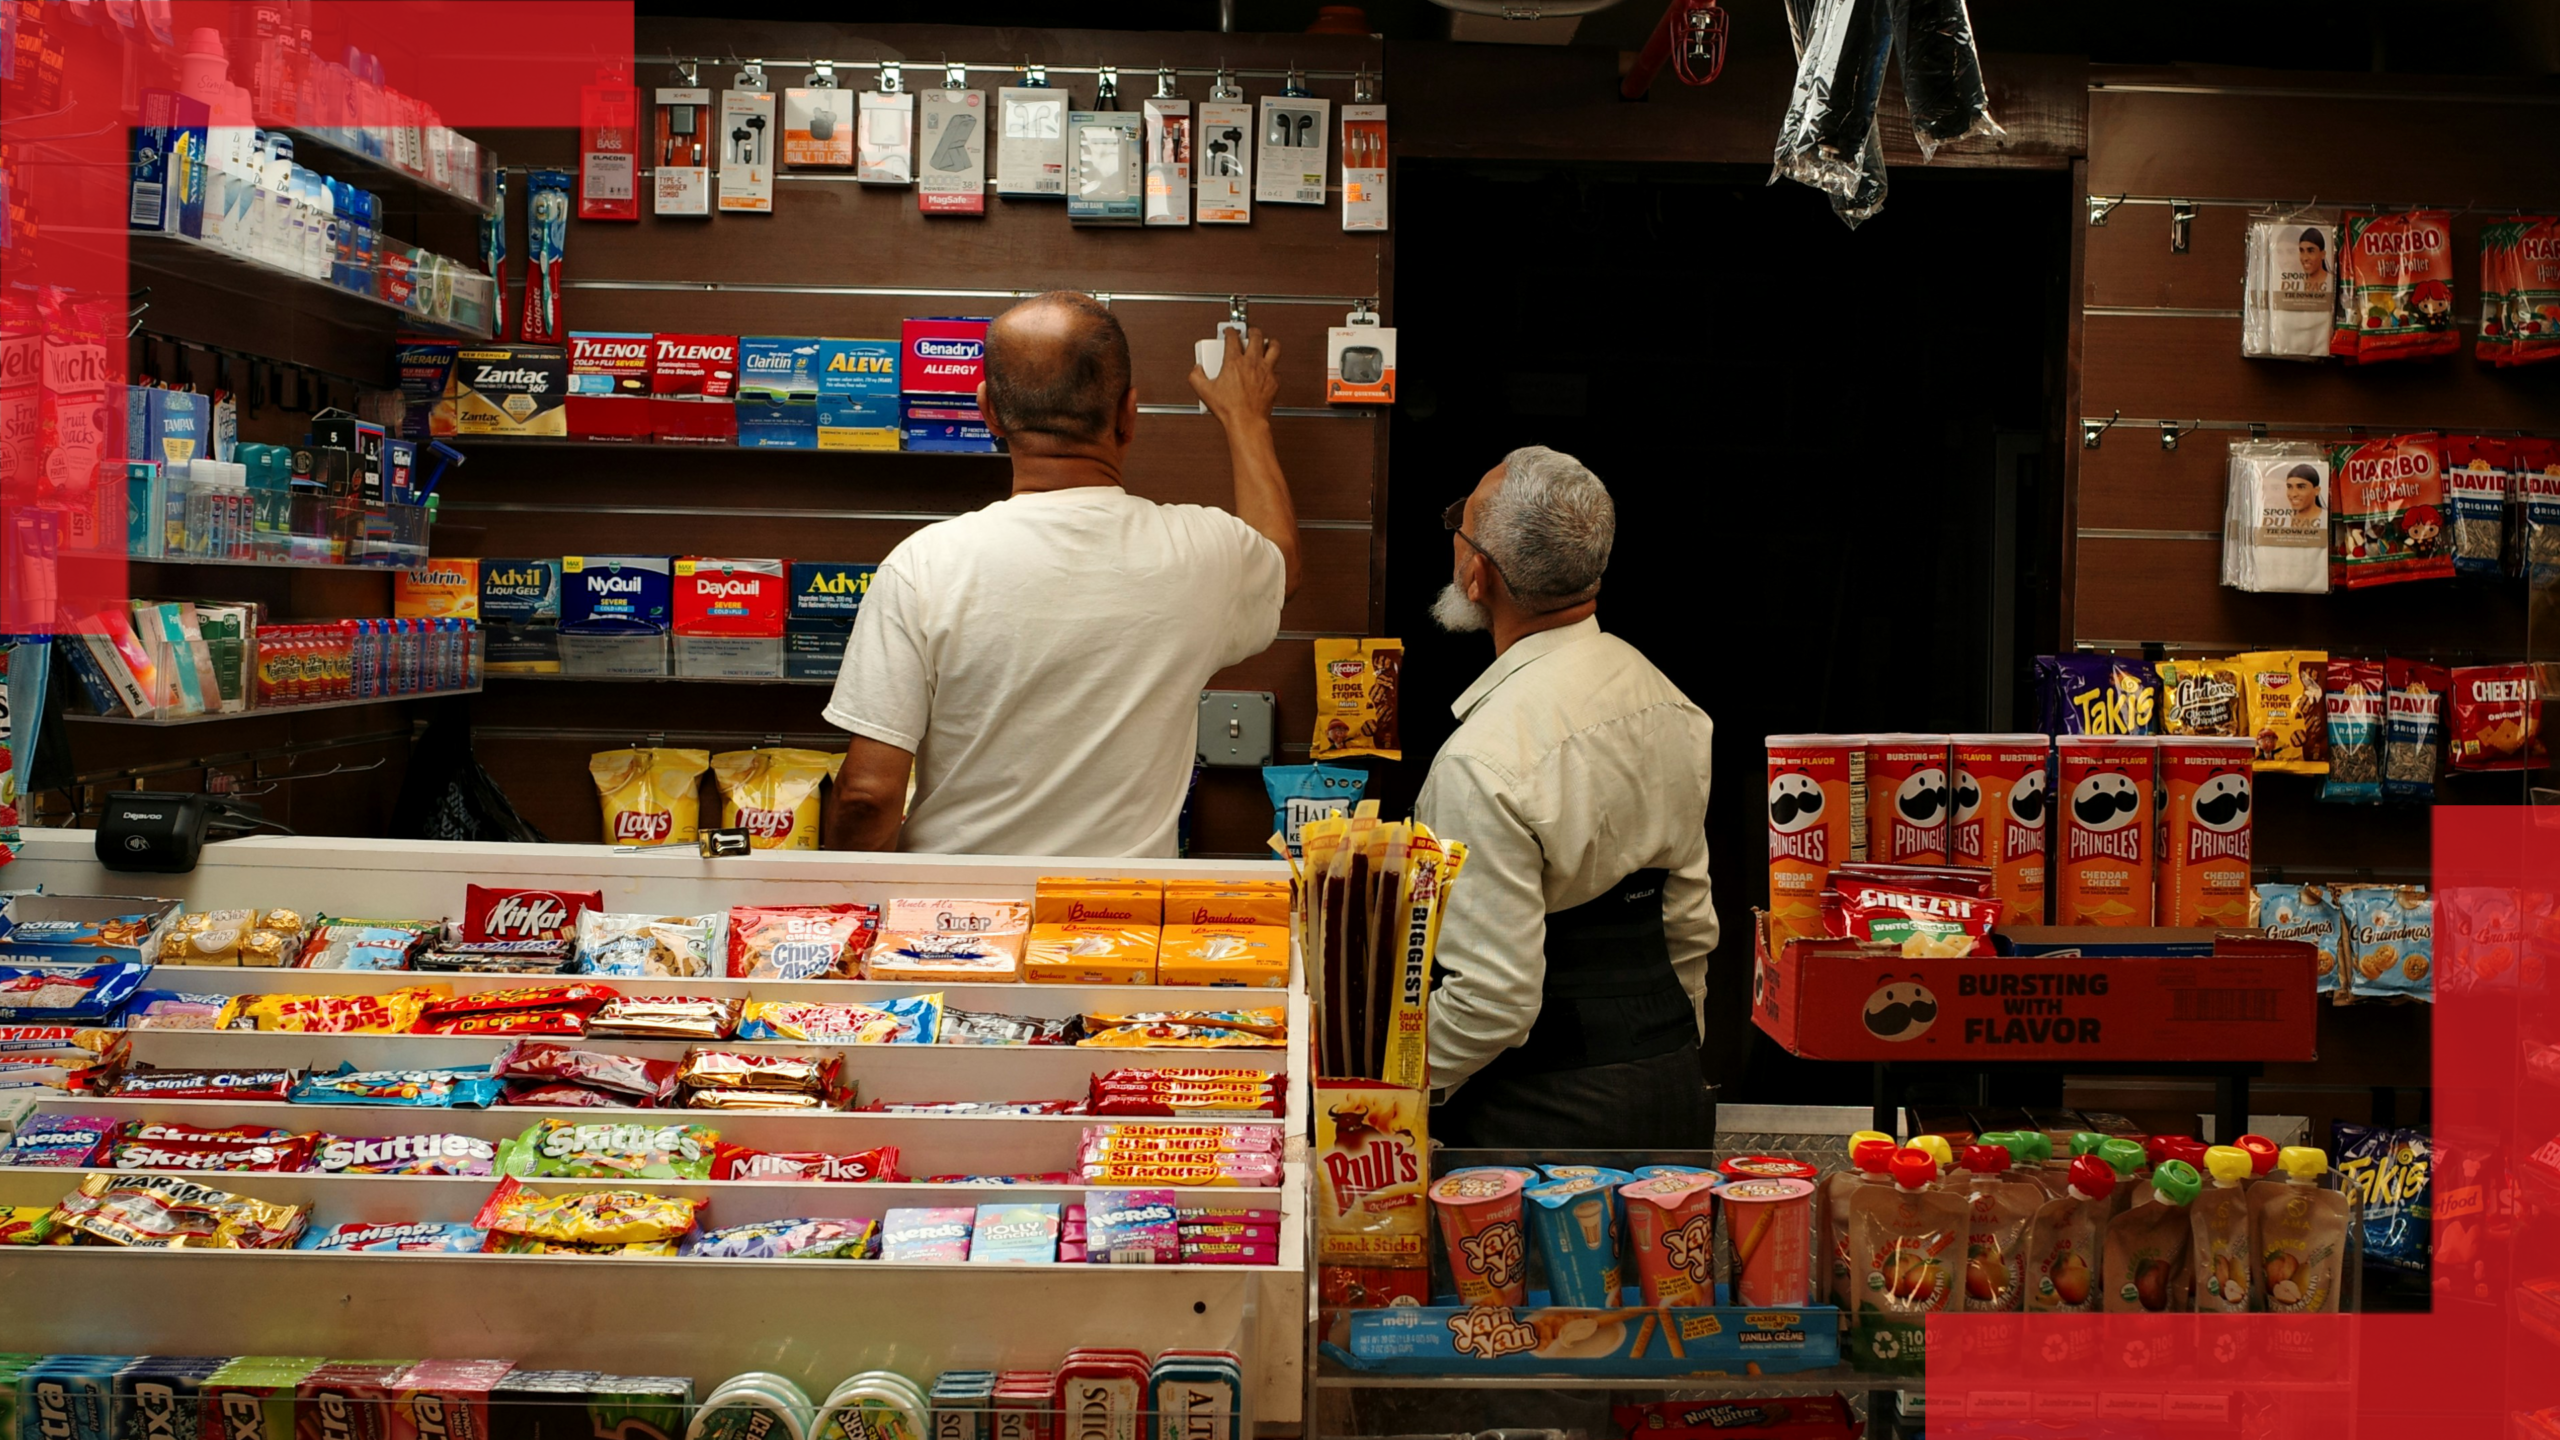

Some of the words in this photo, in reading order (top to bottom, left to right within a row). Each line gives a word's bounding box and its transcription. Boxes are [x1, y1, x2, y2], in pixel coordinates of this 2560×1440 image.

[597, 140, 621, 149] BASS
[787, 152, 810, 162] BUILT
[813, 152, 826, 162] TO
[828, 152, 851, 162] LAST
[928, 195, 967, 204] MagSafe
[2364, 229, 2442, 256] HARIBO
[390, 256, 410, 270] Colgate
[2377, 259, 2400, 278] Harry
[2400, 256, 2430, 272] Potter
[2281, 271, 2311, 281] SPORT
[390, 282, 409, 297] Colgate
[2281, 282, 2301, 292] DU
[2304, 282, 2328, 292] RAG
[533, 287, 542, 334] Colgate
[572, 340, 648, 360] TYLENOL
[656, 341, 734, 361] TYLENOL
[921, 342, 979, 358] Benadryl
[401, 353, 450, 365] THERAFLU
[746, 354, 792, 369] Claritin
[827, 352, 894, 374] ALEVE
[49, 350, 107, 386] Welch's
[657, 368, 676, 376] Extra
[924, 365, 978, 375] ALLERGY
[473, 365, 549, 386] Zantac
[459, 411, 500, 424] Zantac
[163, 418, 195, 433] TAMPAX
[61, 426, 95, 447] Snacks
[2350, 453, 2430, 484] HARIBO
[2453, 472, 2506, 491] DAVID
[2362, 486, 2388, 506] Harry
[2389, 482, 2420, 500] Potter
[2263, 508, 2299, 517] SPORT
[2457, 502, 2503, 512] ORIGINAL
[2262, 517, 2287, 529] DU
[2292, 517, 2321, 528] RAG
[2301, 528, 2319, 536] CAP
[678, 564, 692, 572] MAX
[407, 570, 462, 586] Motrin
[485, 568, 541, 587] Advil
[807, 571, 878, 594] Advil
[486, 585, 541, 596] LIQUI-GELS
[588, 576, 642, 596] NyQuil
[696, 579, 760, 598] DayQuil
[1331, 662, 1364, 676] Keebler
[2258, 672, 2291, 686] Keebler
[1332, 683, 1363, 692] FUDGE
[2472, 680, 2538, 703] CHEEZ-IT
[1331, 692, 1364, 700] STRIPES
[2169, 679, 2239, 722] Linden's
[2260, 693, 2291, 702] FUDGE
[1338, 700, 1358, 708] Minis
[2073, 686, 2155, 736] Takis
[2259, 701, 2292, 710] STRIPES
[2186, 705, 2228, 720] Chocolate
[2267, 710, 2288, 718] Minis
[2488, 710, 2523, 722] ORIGINAL
[2189, 712, 2229, 728] Chippers
[2393, 724, 2439, 736] ORIGINAL
[1802, 757, 1836, 766] FLAVOR
[1886, 753, 1928, 761] BURSTING
[1962, 753, 1992, 762] FLAVOR
[2000, 754, 2037, 762] BURSTING
[2066, 756, 2103, 765] BURSTING
[2121, 757, 2148, 765] FLAVOR
[2184, 757, 2227, 765] BURSTING
[123, 811, 162, 822] Dejavoo
[738, 806, 792, 839] Lay's
[617, 810, 669, 841] Lay's
[2071, 827, 2138, 860] PRINGLES
[2191, 827, 2250, 860] PRINGLES
[1774, 872, 1814, 882] CHEDDAR
[2080, 870, 2129, 880] CHEDDAR
[2203, 871, 2246, 880] CHEDDAR
[1778, 881, 1806, 889] CHEESE
[2087, 879, 2121, 887] CHEESE
[2211, 879, 2241, 887] CHEESE
[896, 899, 926, 909] Uncle
[1859, 888, 1972, 918] CHEEZ-IT
[485, 897, 568, 937] KitKat
[1068, 901, 1132, 923] Bauducco
[1192, 906, 1257, 926] Bauducco
[935, 911, 991, 932] Sugar
[2359, 924, 2431, 945] Grandma's
[774, 941, 831, 965] Chips
[1404, 906, 1429, 1007] BIGGEST
[1029, 969, 1067, 980] Bauducco
[1083, 970, 1104, 978] Wafer
[1218, 976, 1239, 984] Wafer
[1959, 973, 2109, 997] BURSTING
[2004, 998, 2062, 1016] WITH
[1398, 1009, 1424, 1022] Snack
[1399, 1020, 1421, 1032] Stick
[1965, 1018, 2102, 1045] FLAVOR
[3, 1043, 25, 1051] PEANUT
[26, 1042, 53, 1050] CARAMEL
[126, 1077, 206, 1092] Peanut
[210, 1071, 286, 1088] Chews
[542, 1124, 700, 1162] Skittles
[116, 1146, 275, 1169] Skittles
[321, 1133, 494, 1170] Skittles
[819, 1159, 868, 1179] Ike
[1323, 1139, 1419, 1218] Bull's
[2338, 1156, 2429, 1206] Takis
[107, 1175, 229, 1205] HARIBO
[1369, 1195, 1408, 1211] Original
[1486, 1208, 1514, 1222] meiji
[983, 1222, 1041, 1236] JOLLY
[1893, 1220, 1922, 1229] AMA
[2281, 1220, 2313, 1232] AMA
[399, 1233, 453, 1245] bites
[985, 1231, 1046, 1241] rancher
[1329, 1237, 1369, 1251] Snack
[1373, 1238, 1417, 1251] Sticks
[1382, 1313, 1418, 1329] meiji
[1746, 1315, 1774, 1324] CRACKER
[1776, 1315, 1799, 1324] STICK
[1740, 1331, 1773, 1342] VANILLA
[1907, 1330, 1944, 1346] 100%
[2278, 1328, 2314, 1345] 100%
[2105, 1399, 2137, 1410] Junior
[2171, 1400, 2204, 1411] Junior
[1684, 1405, 1732, 1426] Nutter
[1711, 1408, 1759, 1427] Butter
[450, 1409, 463, 1437] PINK
